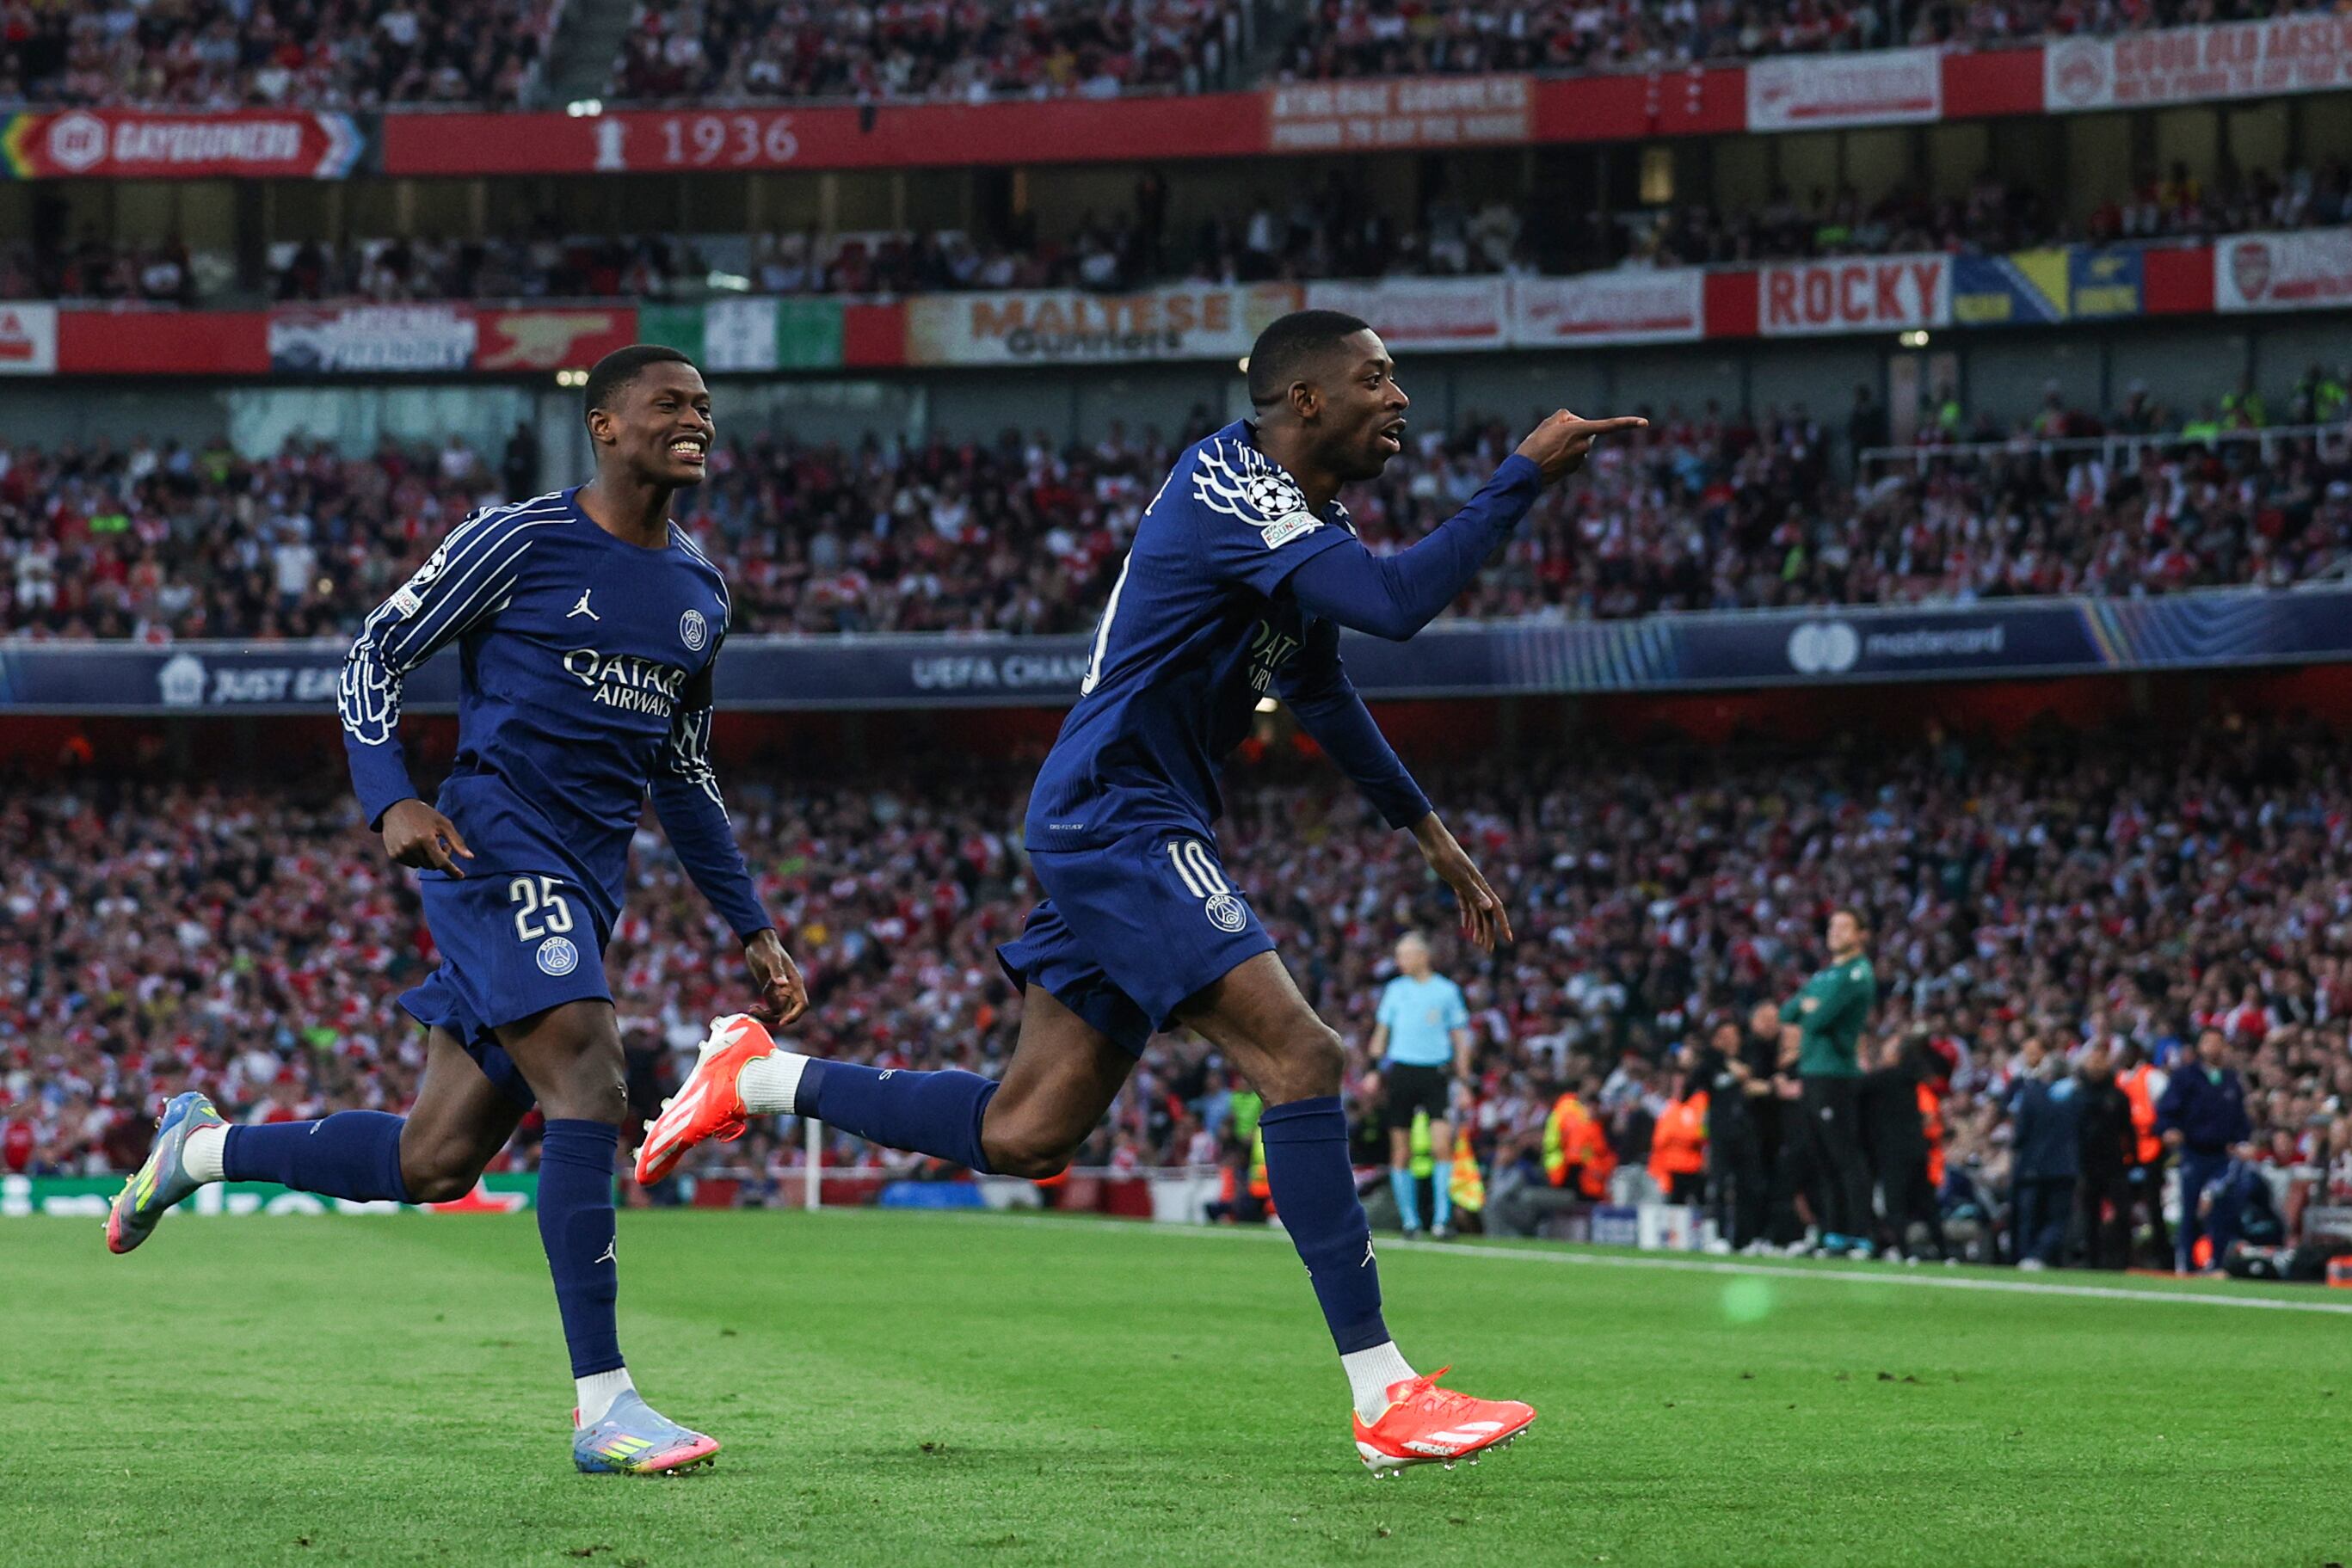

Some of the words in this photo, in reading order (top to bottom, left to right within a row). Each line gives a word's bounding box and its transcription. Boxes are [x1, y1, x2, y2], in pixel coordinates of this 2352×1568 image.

[662, 116, 799, 163] 1936
[1769, 260, 1942, 324] ROCKY
[970, 293, 1232, 339] MALTESE
[211, 667, 292, 704] JUST
[295, 667, 341, 701] EA
[563, 649, 687, 698] QATAR
[912, 655, 998, 688] UEFA
[593, 683, 671, 717] AIRWAYS
[1167, 839, 1231, 898] 10
[508, 876, 574, 942] 25
[1208, 895, 1231, 910] PARIS
[540, 939, 569, 951] PARIS
